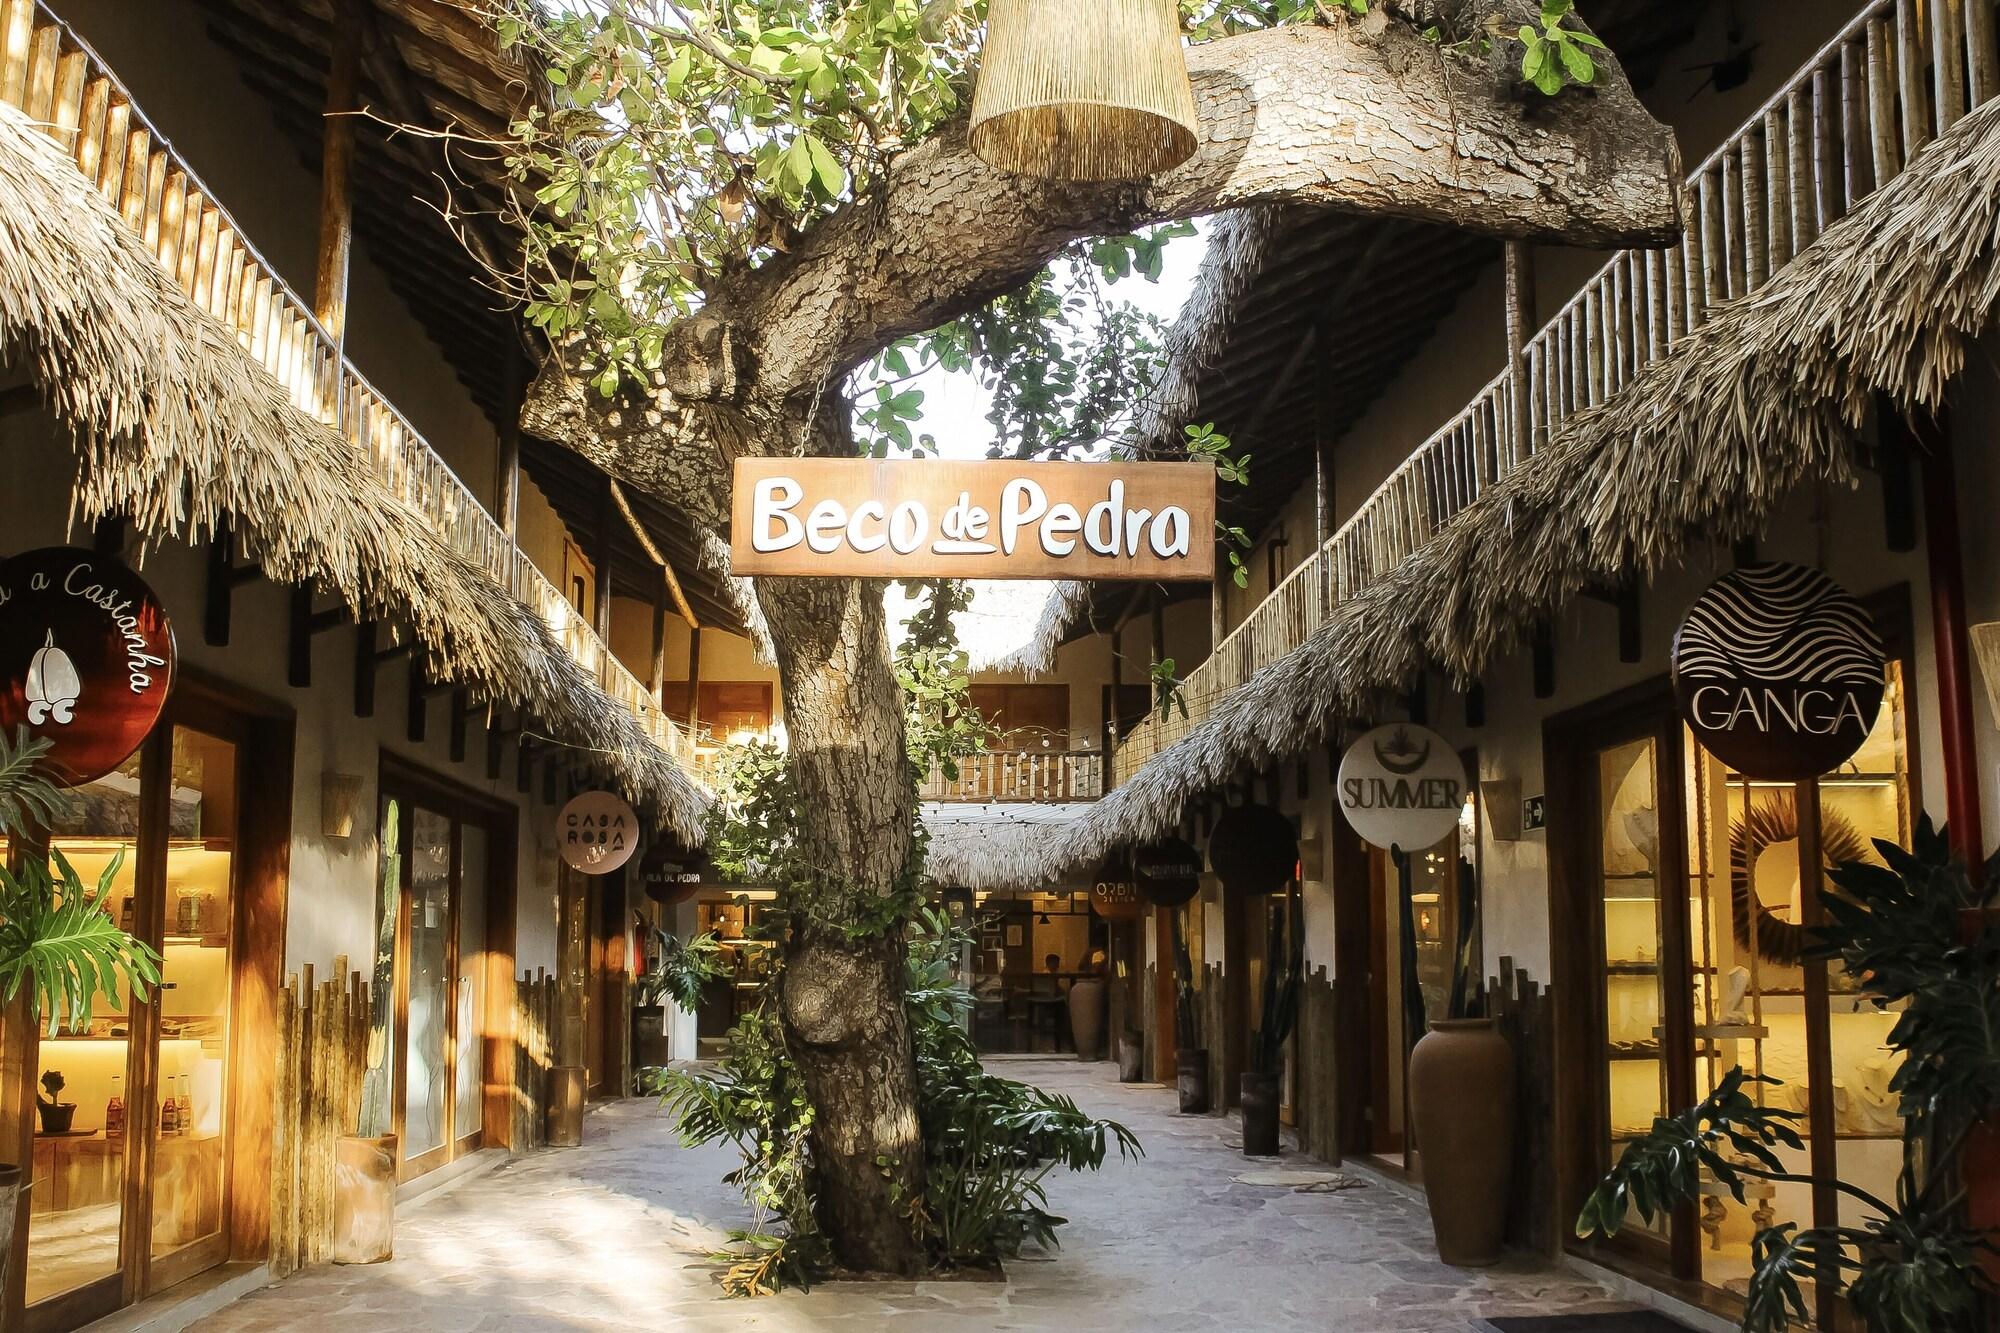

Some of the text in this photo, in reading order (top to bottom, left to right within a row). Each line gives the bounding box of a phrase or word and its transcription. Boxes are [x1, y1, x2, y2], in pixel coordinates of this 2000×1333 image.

[752, 476, 1192, 559] Beco de Pedra
[64, 563, 168, 694] Castanha
[1692, 686, 1868, 736] GANGA
[1344, 778, 1464, 809] SUMMER
[567, 814, 625, 828] CASA
[567, 831, 625, 848] ROSA
[677, 873, 701, 884] PEDRA
